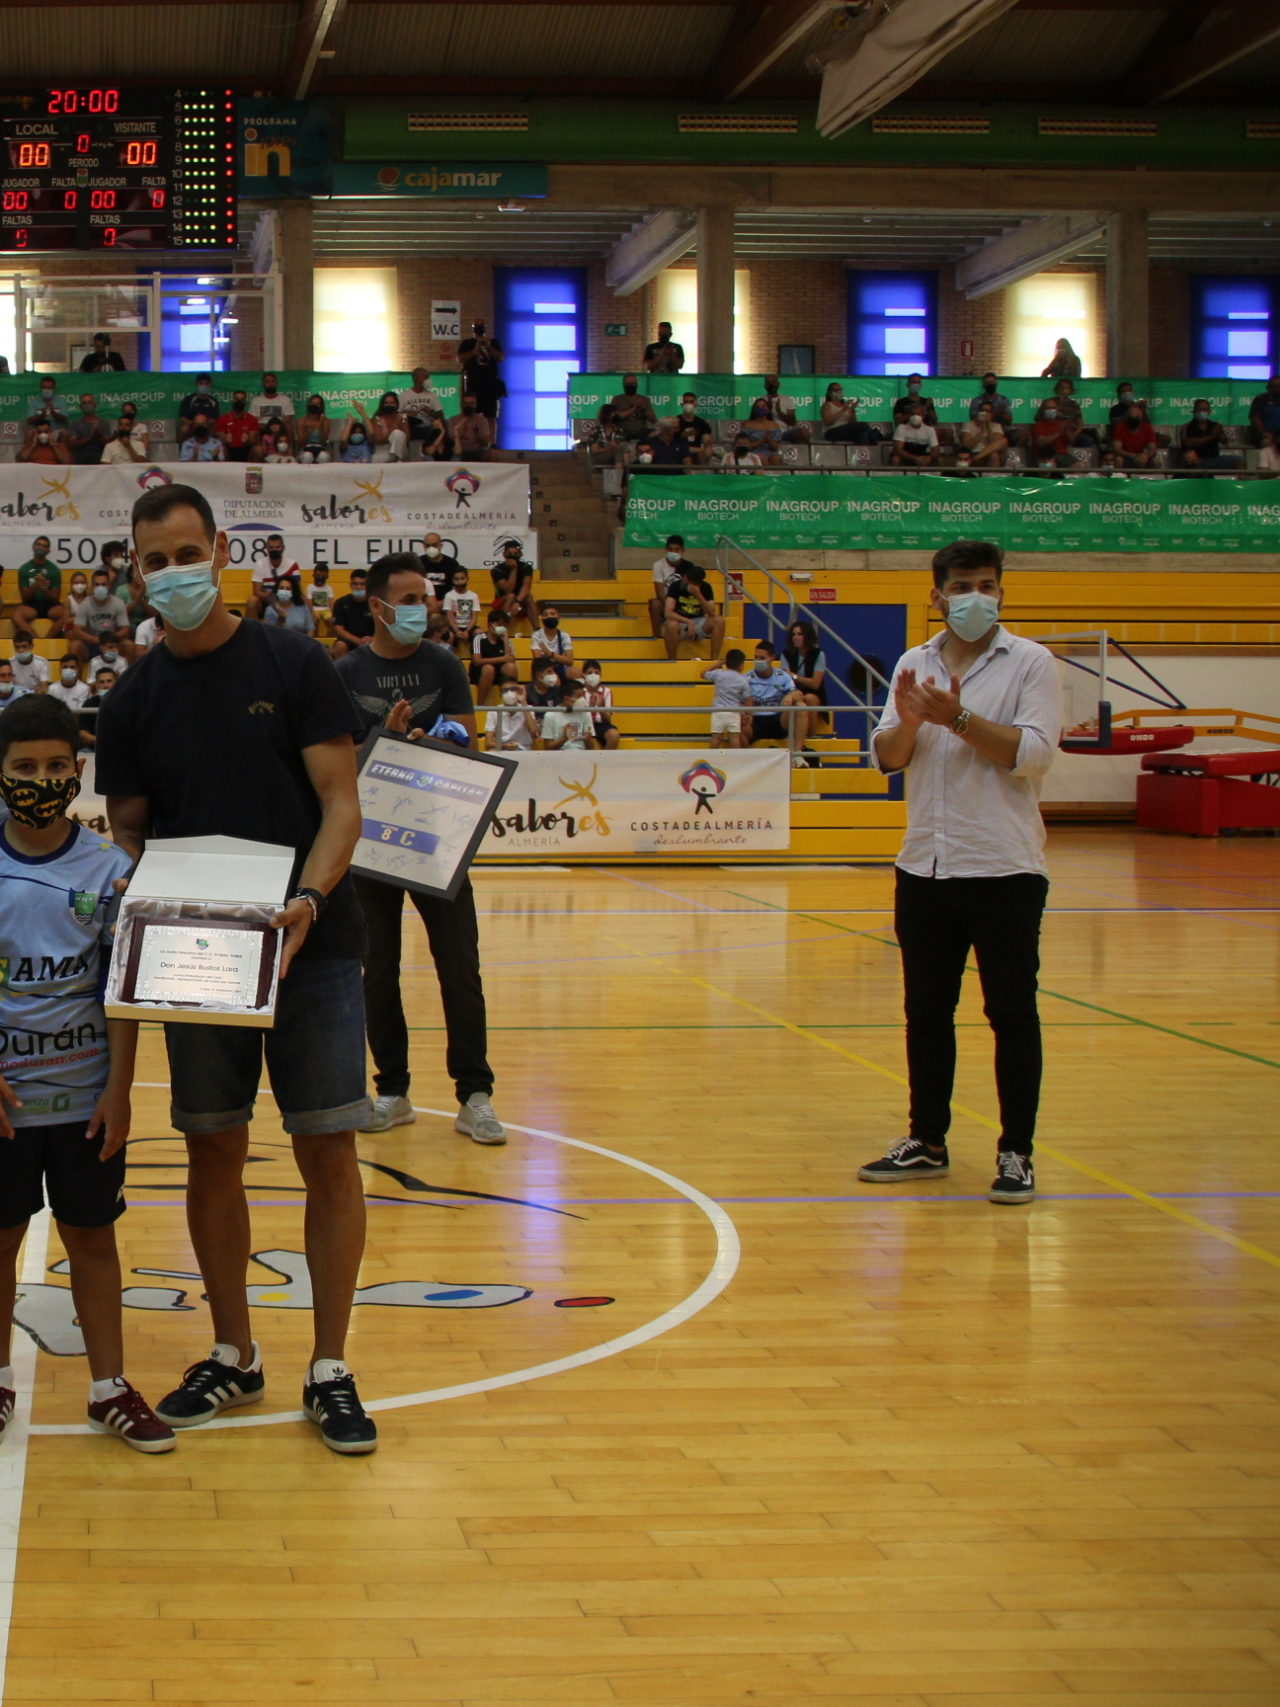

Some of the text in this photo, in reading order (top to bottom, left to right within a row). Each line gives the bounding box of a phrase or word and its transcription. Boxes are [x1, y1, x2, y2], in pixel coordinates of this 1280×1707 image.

[174, 89, 183, 97] 4
[47, 89, 120, 114] 20:00
[174, 102, 183, 111] 5
[174, 116, 183, 125] 6
[244, 117, 297, 126] PROGRAMA
[15, 123, 59, 135] LOCAL
[114, 121, 157, 134] VISITANTE
[174, 129, 183, 138] 7
[76, 134, 89, 153] 0
[174, 142, 183, 152] 8
[19, 143, 50, 166] 00
[126, 141, 158, 165] 00
[68, 157, 99, 169] PERIODO
[174, 155, 183, 165] 9
[171, 169, 183, 178] 10
[404, 166, 502, 192] cajamar
[2, 178, 40, 189] JUGADOR
[51, 177, 76, 187] FALTA
[88, 177, 126, 187] JUGADOR
[142, 176, 167, 186] FALTA
[171, 182, 183, 191] 11
[2, 192, 28, 211] 00
[63, 191, 77, 209] 0
[90, 190, 116, 209] 00
[171, 196, 183, 205] 12
[171, 209, 183, 219] 13
[2, 215, 33, 226] FALTAS
[89, 215, 121, 225] FALTAS
[171, 222, 183, 232] 14
[171, 236, 183, 245] 15
[100, 391, 165, 402] INAGROUP
[319, 388, 385, 401] INAGROUP
[223, 498, 285, 509] DIPUTACIÓN
[301, 494, 392, 523] sabores
[684, 499, 758, 512] INAGROUP
[766, 500, 839, 513] INAGROUP
[847, 501, 921, 513] INAGROUP
[928, 502, 1001, 514] INAGROUP
[1009, 502, 1082, 514] INAGROUP
[1089, 503, 1162, 515] INAGROUP
[224, 508, 284, 518] DE ALMERÍA
[1169, 504, 1241, 516] INAGROUP
[407, 511, 516, 521] COSTADEALMERÍA
[697, 512, 739, 521] BIOTECH
[779, 512, 820, 521] BIOTECH
[861, 512, 902, 522] BIOTECH
[941, 514, 982, 523] BIOTECH
[1022, 514, 1063, 523] BIOTECH
[1102, 515, 1143, 524] BIOTECH
[1181, 516, 1222, 525] BIOTECH
[314, 539, 349, 565] EL
[371, 763, 416, 781] ETERNO
[490, 798, 613, 838] sabores
[631, 818, 773, 831] COSTADEALMERÍA
[381, 828, 416, 847] 8 C
[508, 835, 561, 848] ALMERÍA
[653, 832, 747, 846] deslumbrante
[160, 961, 175, 969] Don
[222, 965, 239, 973] Lara
